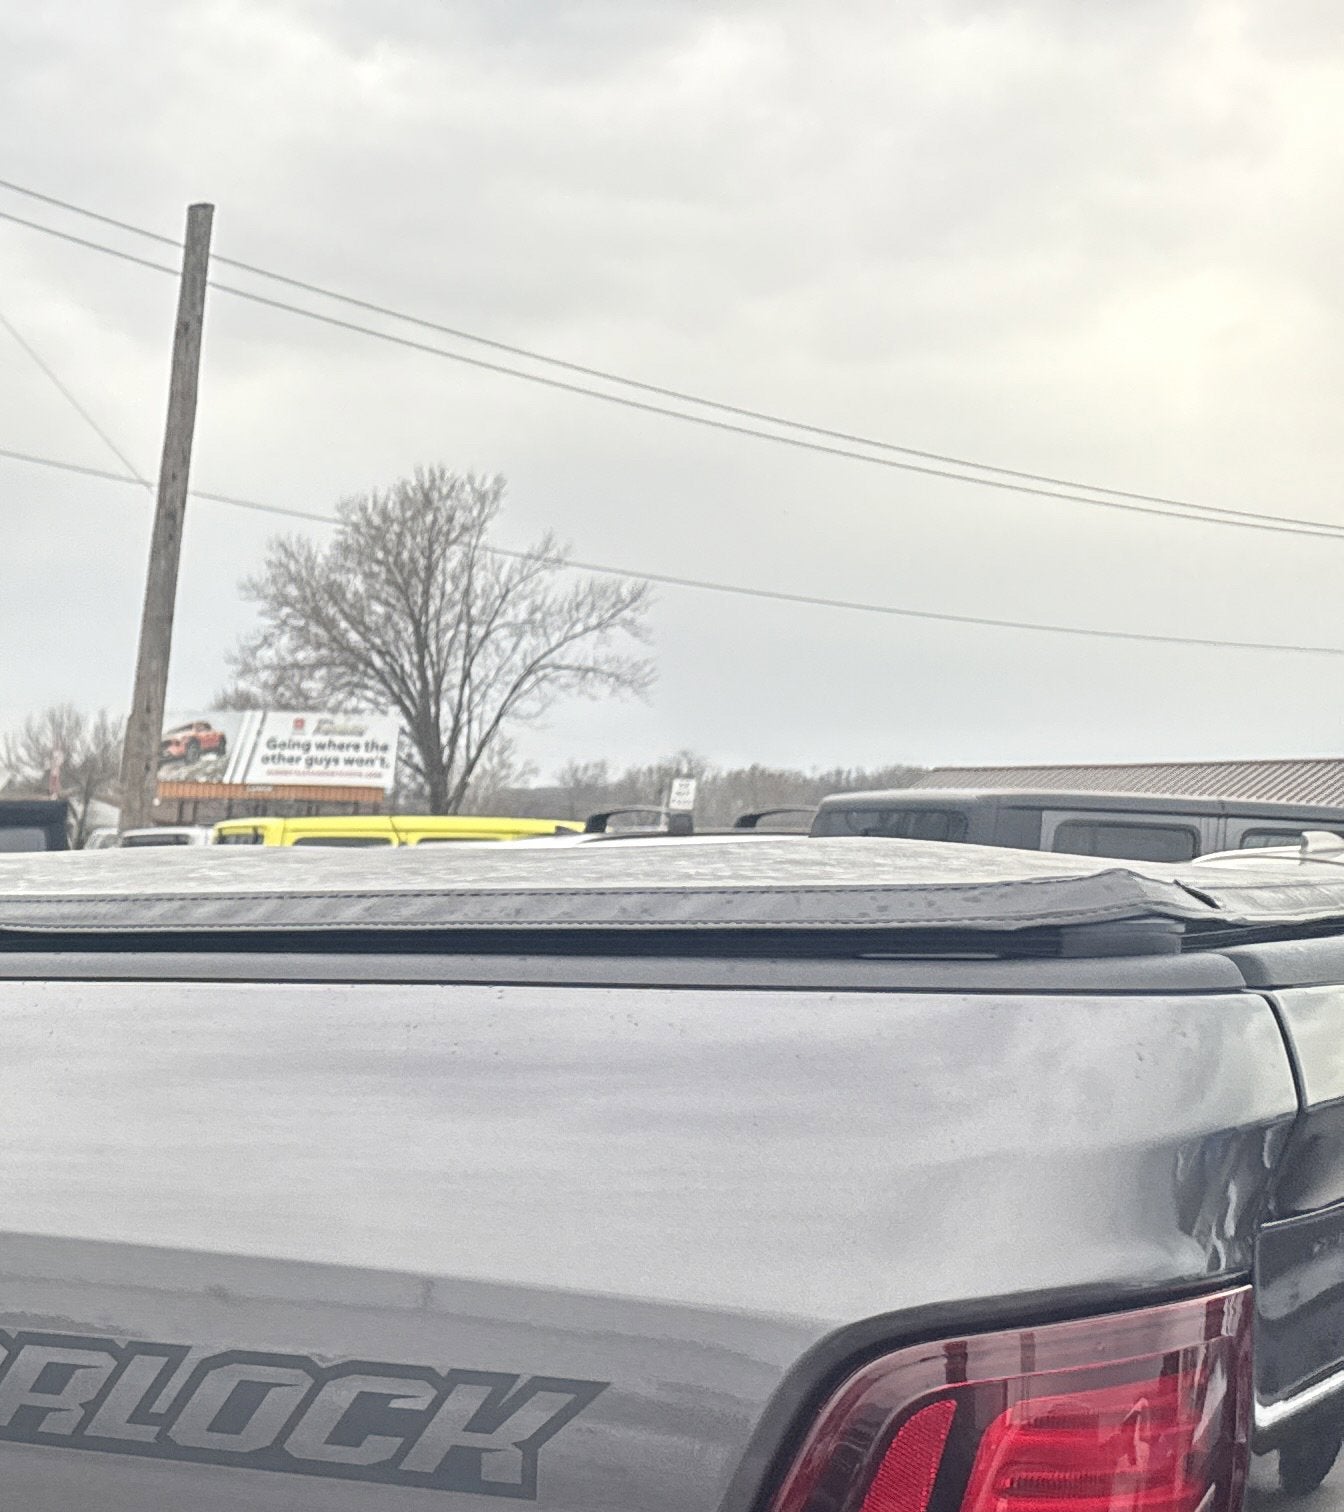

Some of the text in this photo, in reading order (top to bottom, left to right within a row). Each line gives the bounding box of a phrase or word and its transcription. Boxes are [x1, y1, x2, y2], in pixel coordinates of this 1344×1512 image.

[266, 737, 389, 753] Going where the
[261, 753, 302, 765] other
[305, 756, 340, 769] guys
